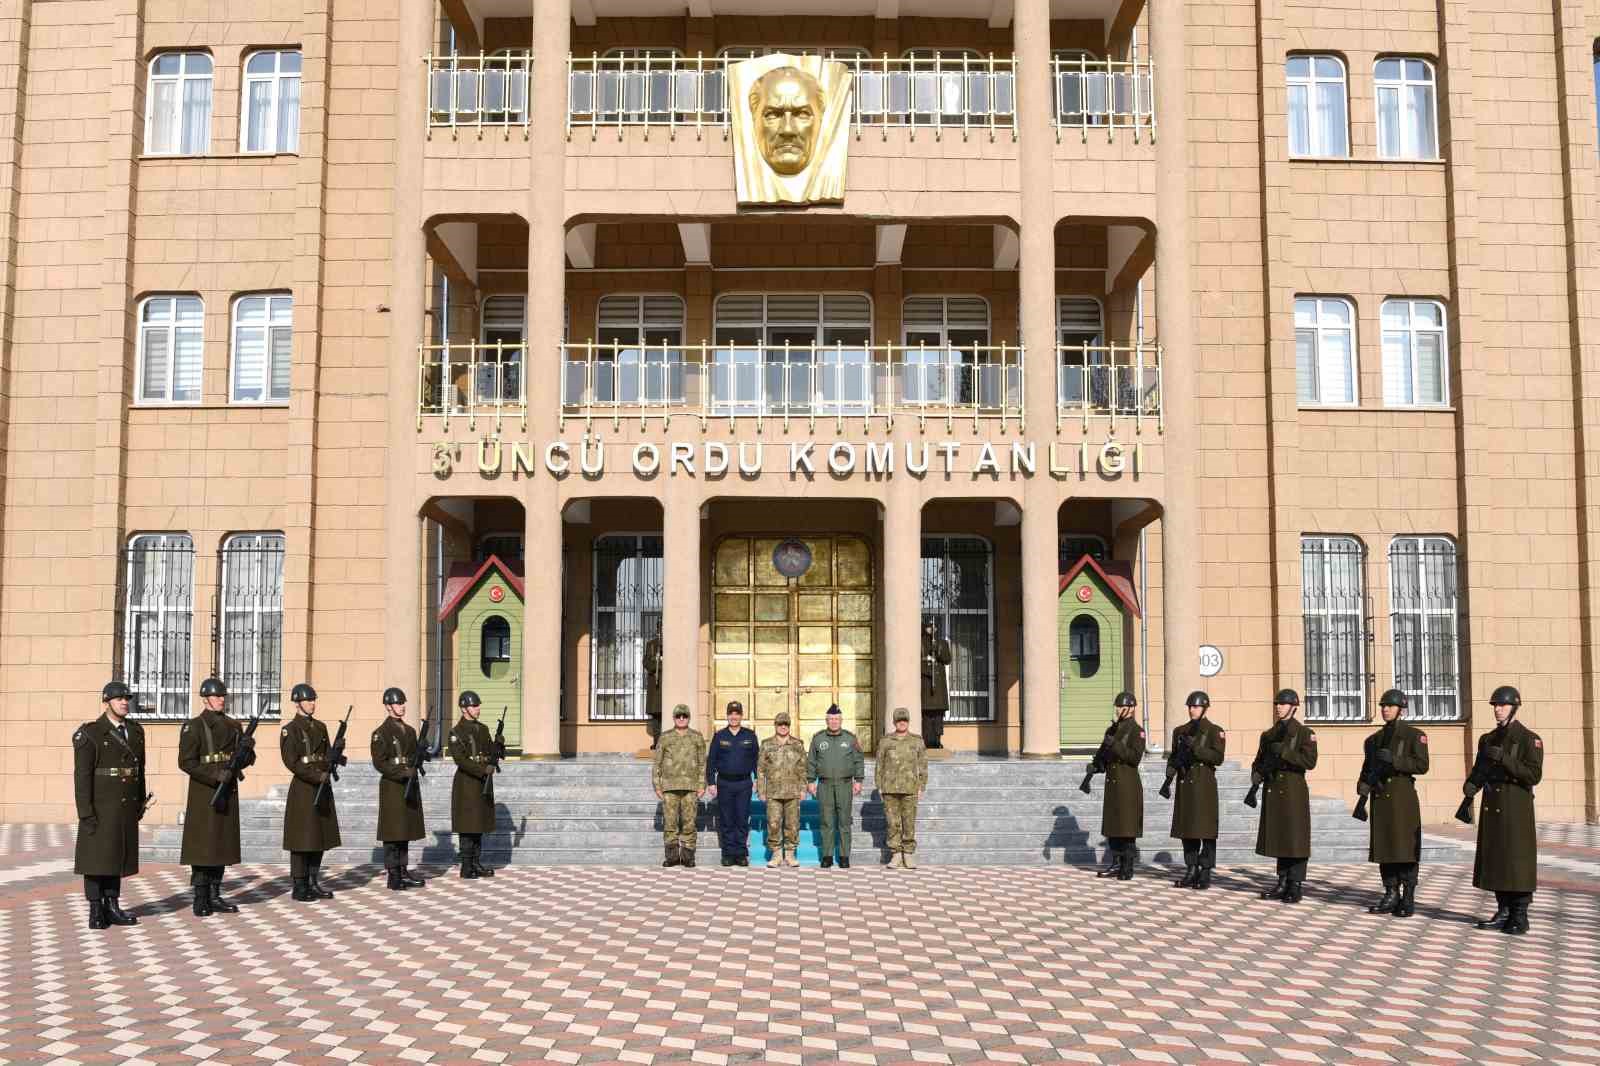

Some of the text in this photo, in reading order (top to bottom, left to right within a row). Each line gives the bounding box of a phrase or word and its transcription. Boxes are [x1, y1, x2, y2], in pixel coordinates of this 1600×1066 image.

[632, 442, 762, 474] ORDU
[790, 434, 1143, 473] KOMUTANLIĞI
[1199, 654, 1219, 667] 03
